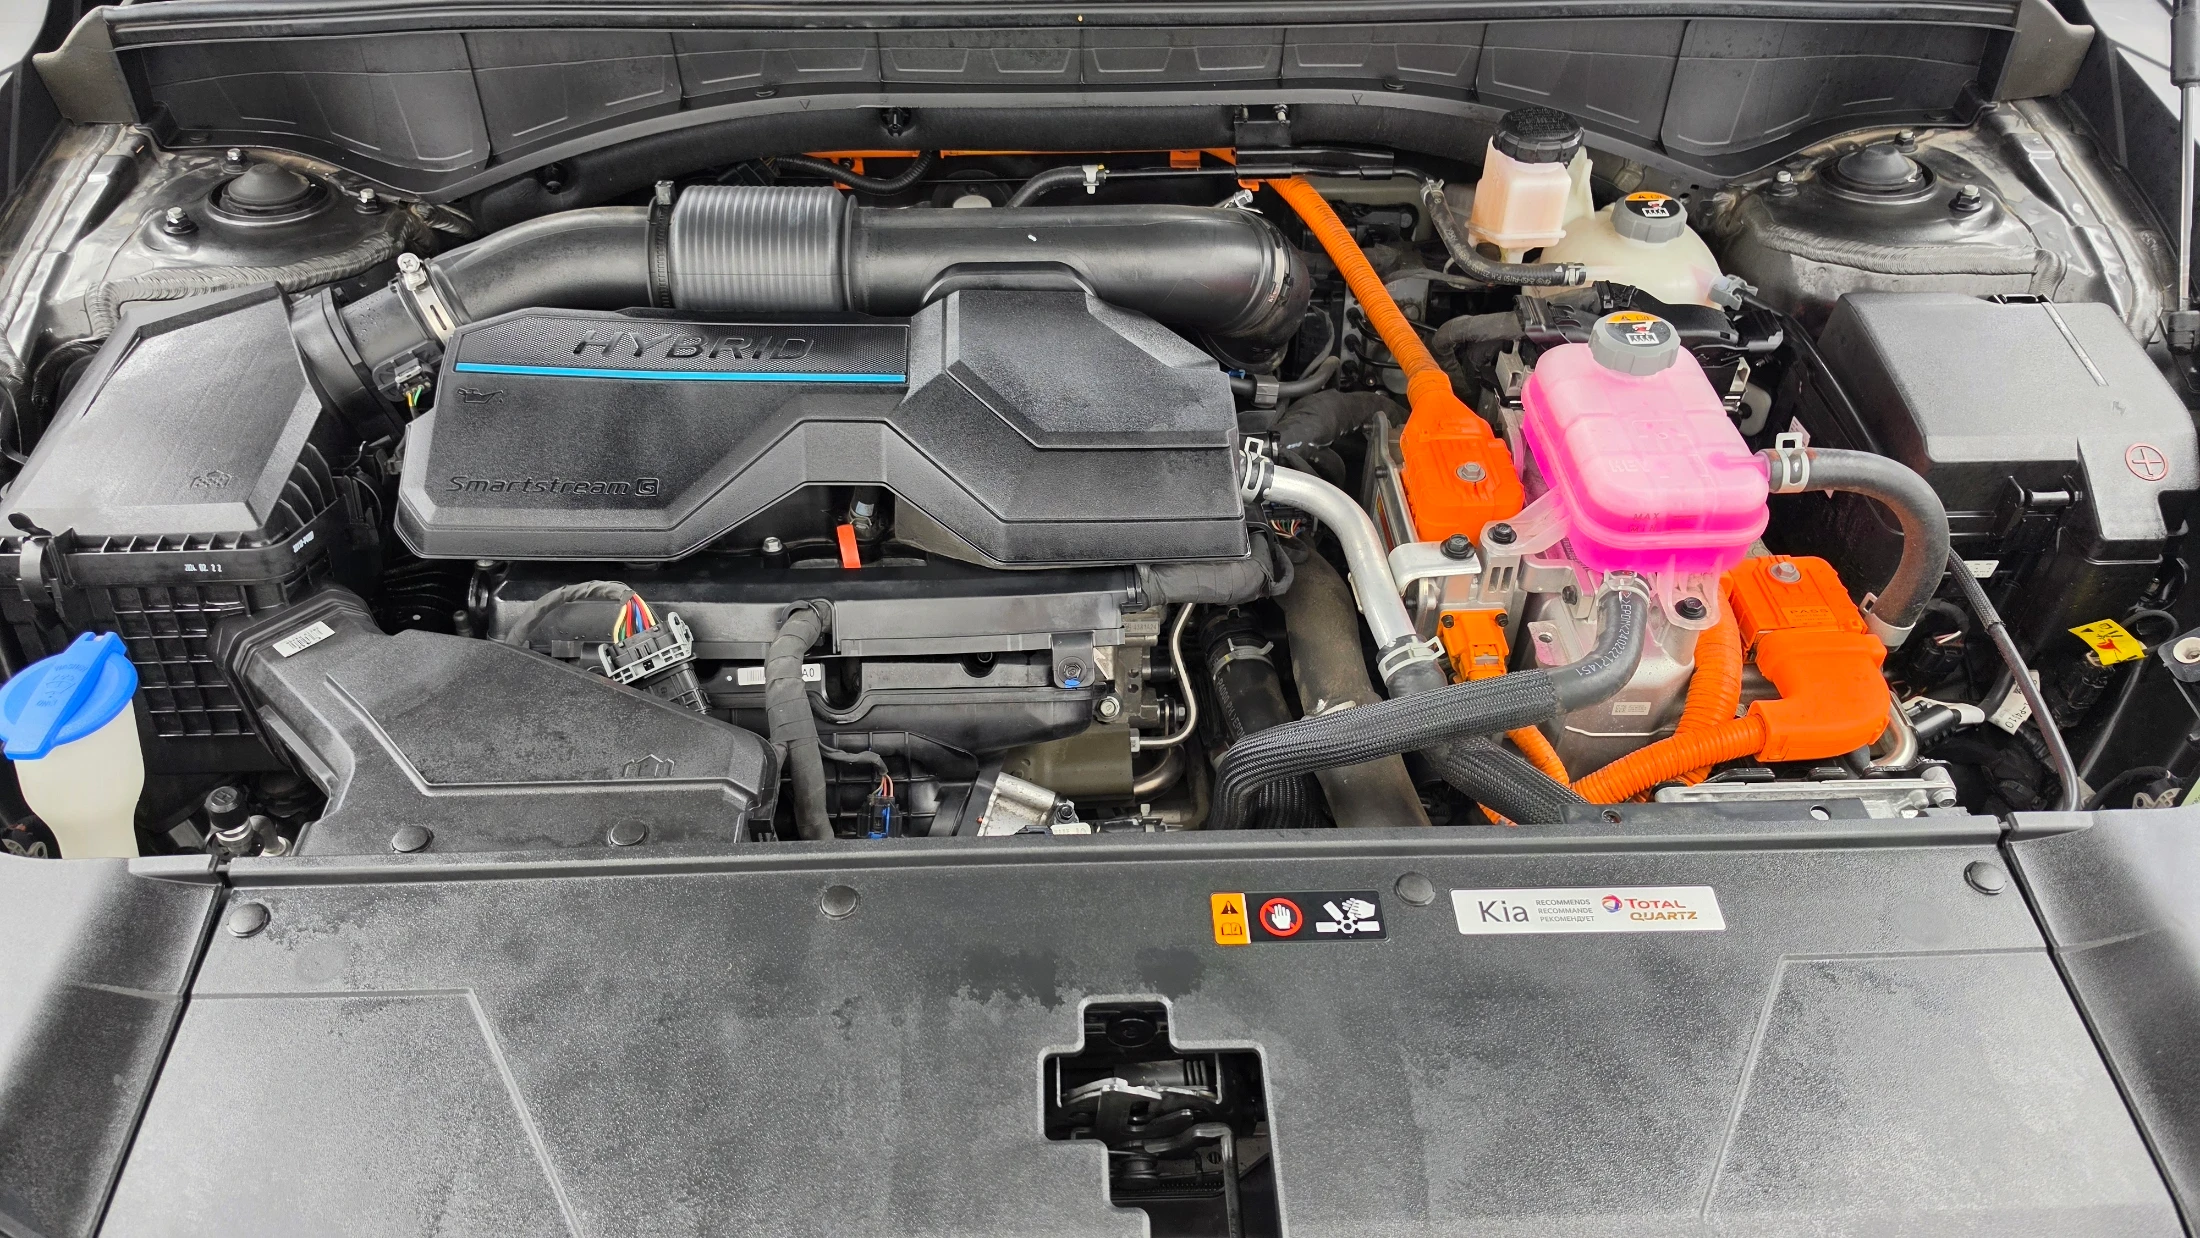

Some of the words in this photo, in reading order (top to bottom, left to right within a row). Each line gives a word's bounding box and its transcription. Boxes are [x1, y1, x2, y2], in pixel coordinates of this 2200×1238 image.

[572, 330, 814, 360] HYBRID
[445, 475, 630, 495] Smartstream
[1633, 512, 1660, 521] MAX
[1624, 898, 1687, 909] TOTAL
[1477, 900, 1529, 923] Kia
[1537, 907, 1593, 915] RECOMMANDE
[1629, 911, 1699, 921] QUARTZ
[1540, 915, 1595, 923] РЕКОМЕНДУЕТ
